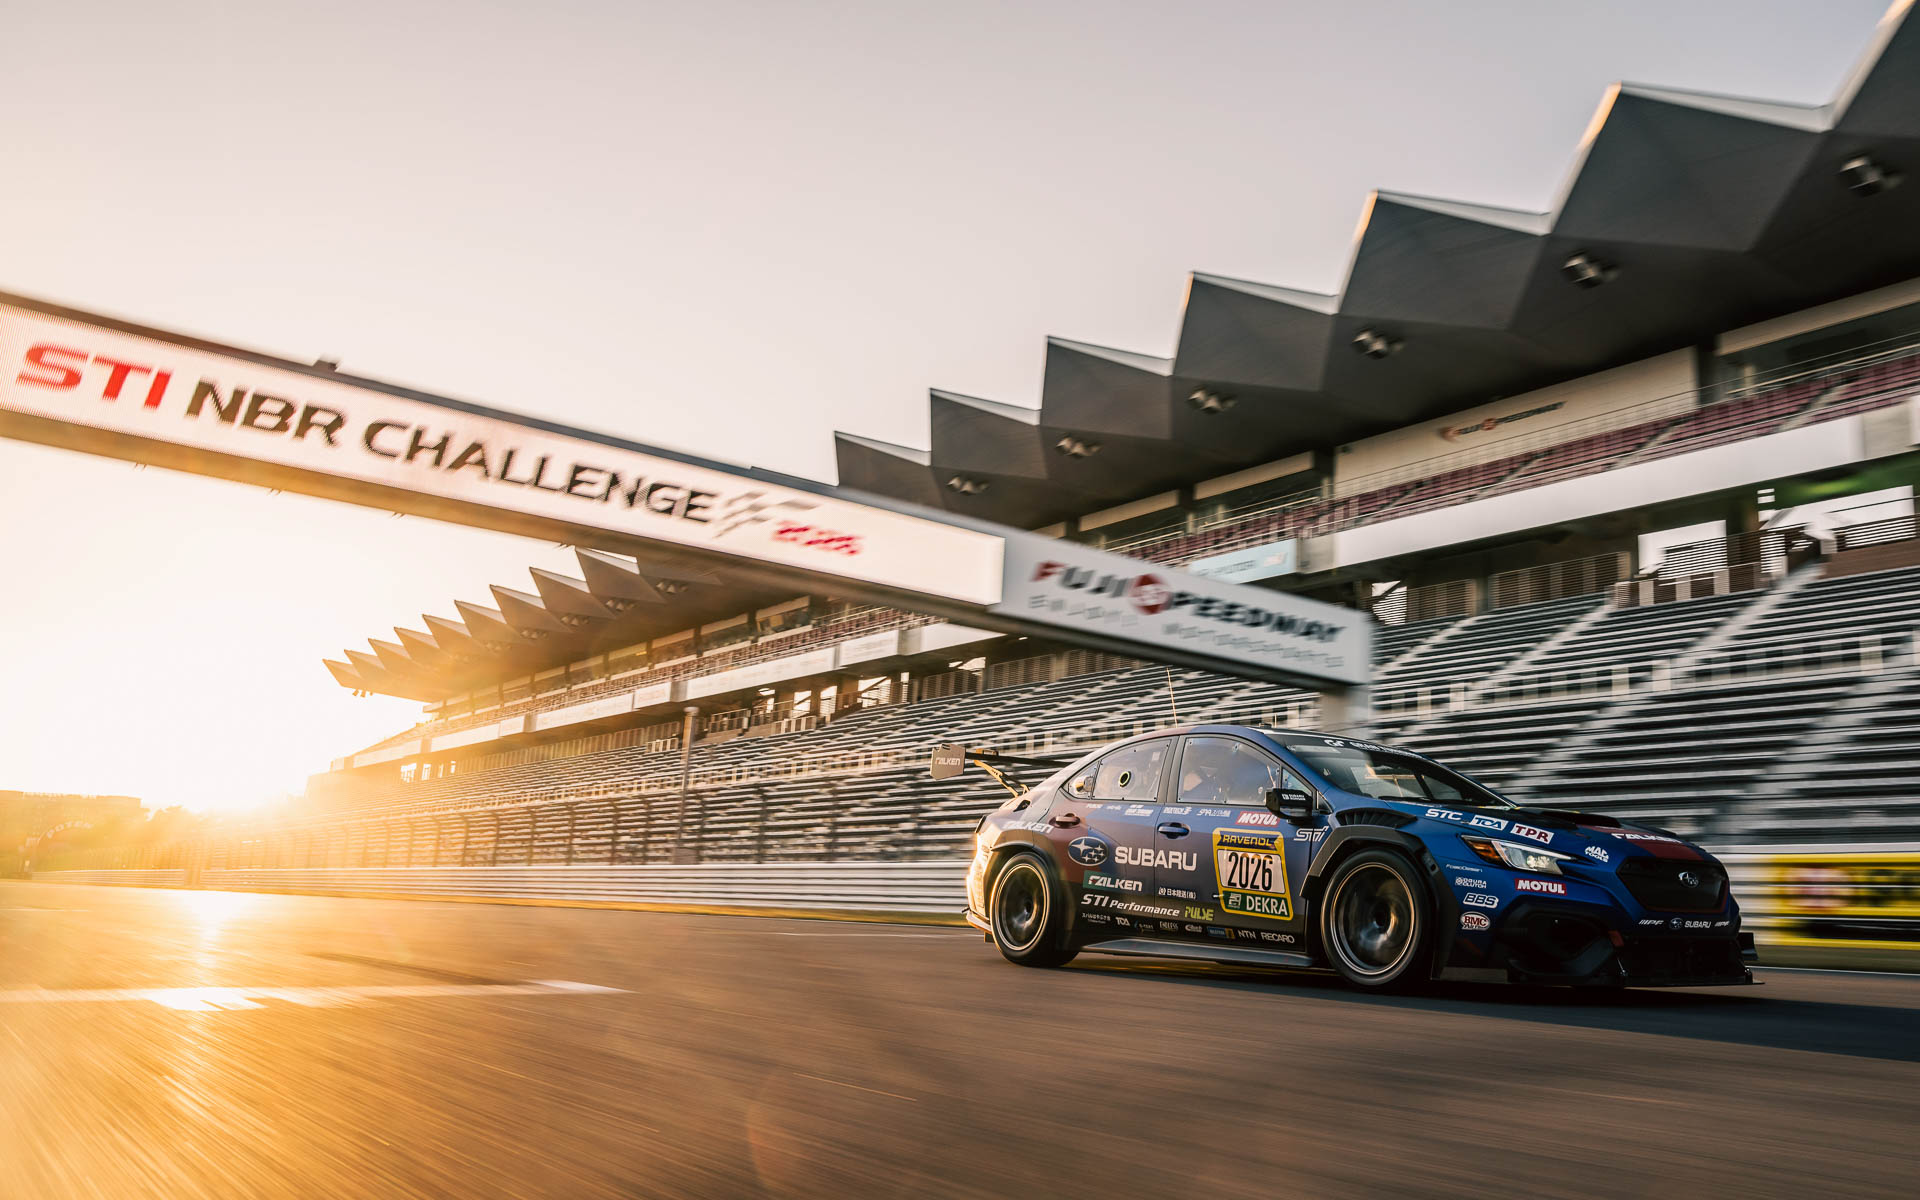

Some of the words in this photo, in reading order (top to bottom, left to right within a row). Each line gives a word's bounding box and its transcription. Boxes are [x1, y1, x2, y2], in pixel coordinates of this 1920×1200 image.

[17, 342, 173, 409] STI
[183, 376, 348, 448] NBR
[361, 418, 716, 526] CHALLENGE
[1030, 560, 1131, 600] FUJI
[1237, 812, 1278, 826] MOTUL
[1425, 808, 1463, 821] STC
[1222, 834, 1274, 847] RAVENOL
[1515, 824, 1549, 843] TPR
[1114, 846, 1198, 872] SUBARU
[1585, 845, 1608, 858] MAC
[1228, 851, 1273, 891] 2026
[1088, 875, 1142, 892] FALKEN
[1517, 879, 1565, 894] MOTUL
[1081, 893, 1110, 907] STI
[1109, 899, 1181, 917] Performance
[1246, 895, 1289, 916] DEKRA
[1464, 893, 1498, 908] BBS
[1184, 906, 1215, 922] PULSE
[1464, 915, 1487, 927] BMC
[1684, 920, 1712, 929] SUBARU
[1237, 929, 1256, 940] NTN
[1260, 931, 1295, 944] RECARO
